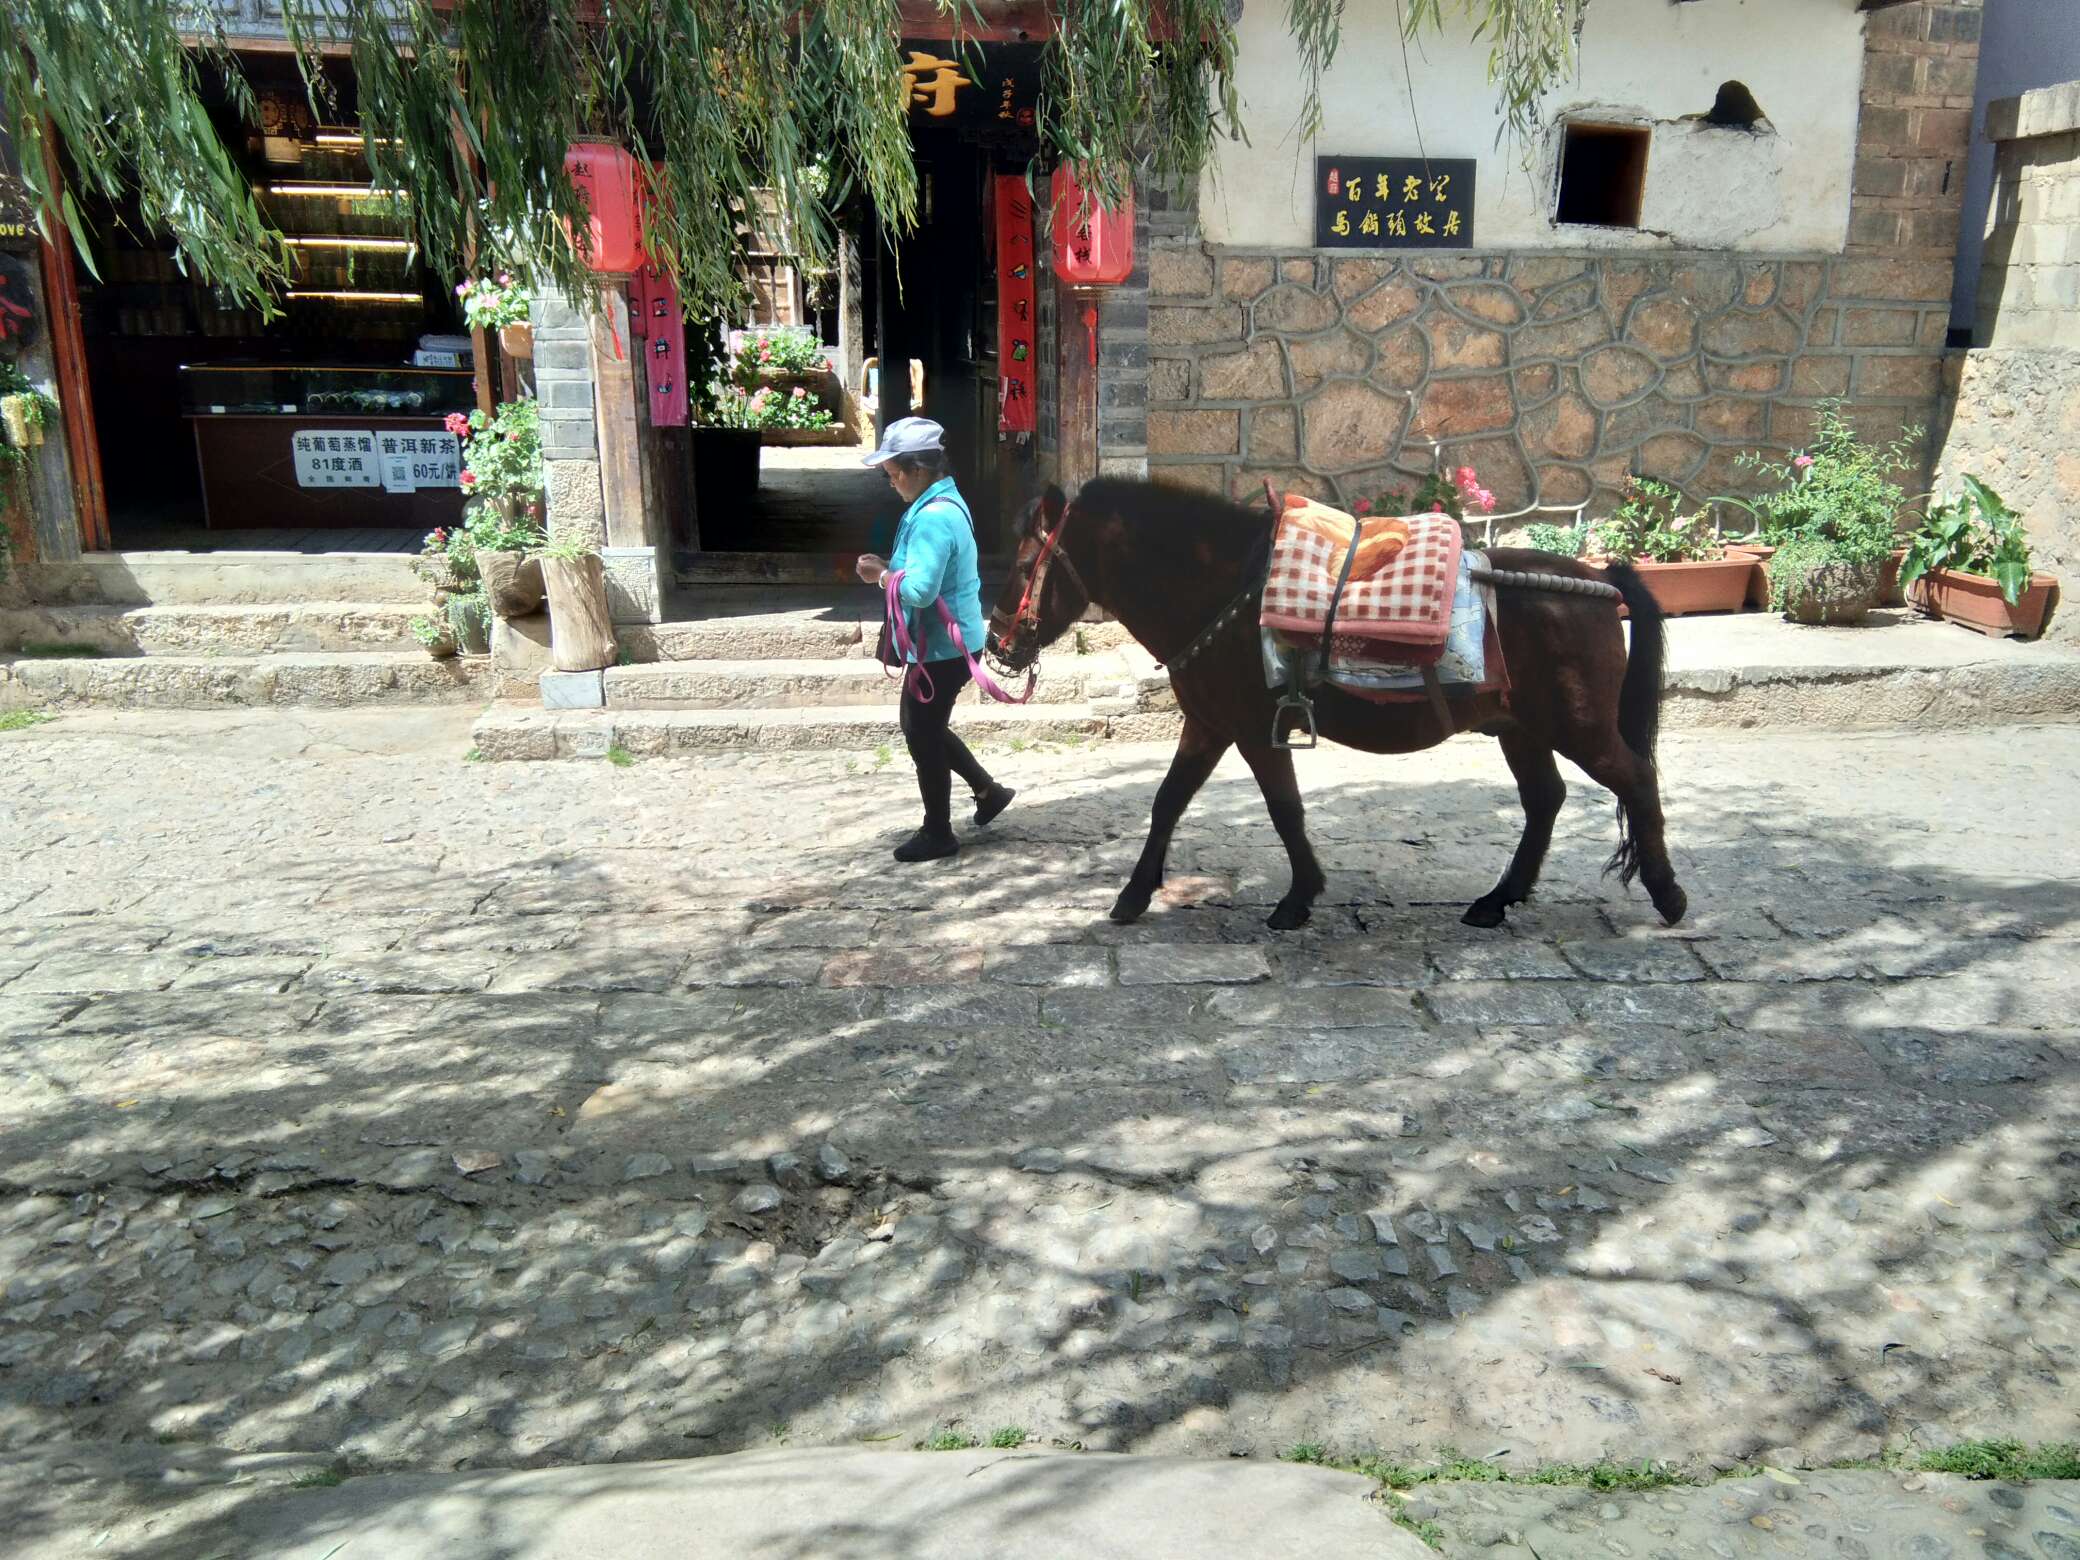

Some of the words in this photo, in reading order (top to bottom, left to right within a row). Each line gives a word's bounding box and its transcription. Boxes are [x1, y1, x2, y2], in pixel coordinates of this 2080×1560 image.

[297, 437, 372, 452] 纯葡萄蒸馏
[382, 438, 456, 455] 普洱新茶
[312, 457, 363, 472] 81度酒
